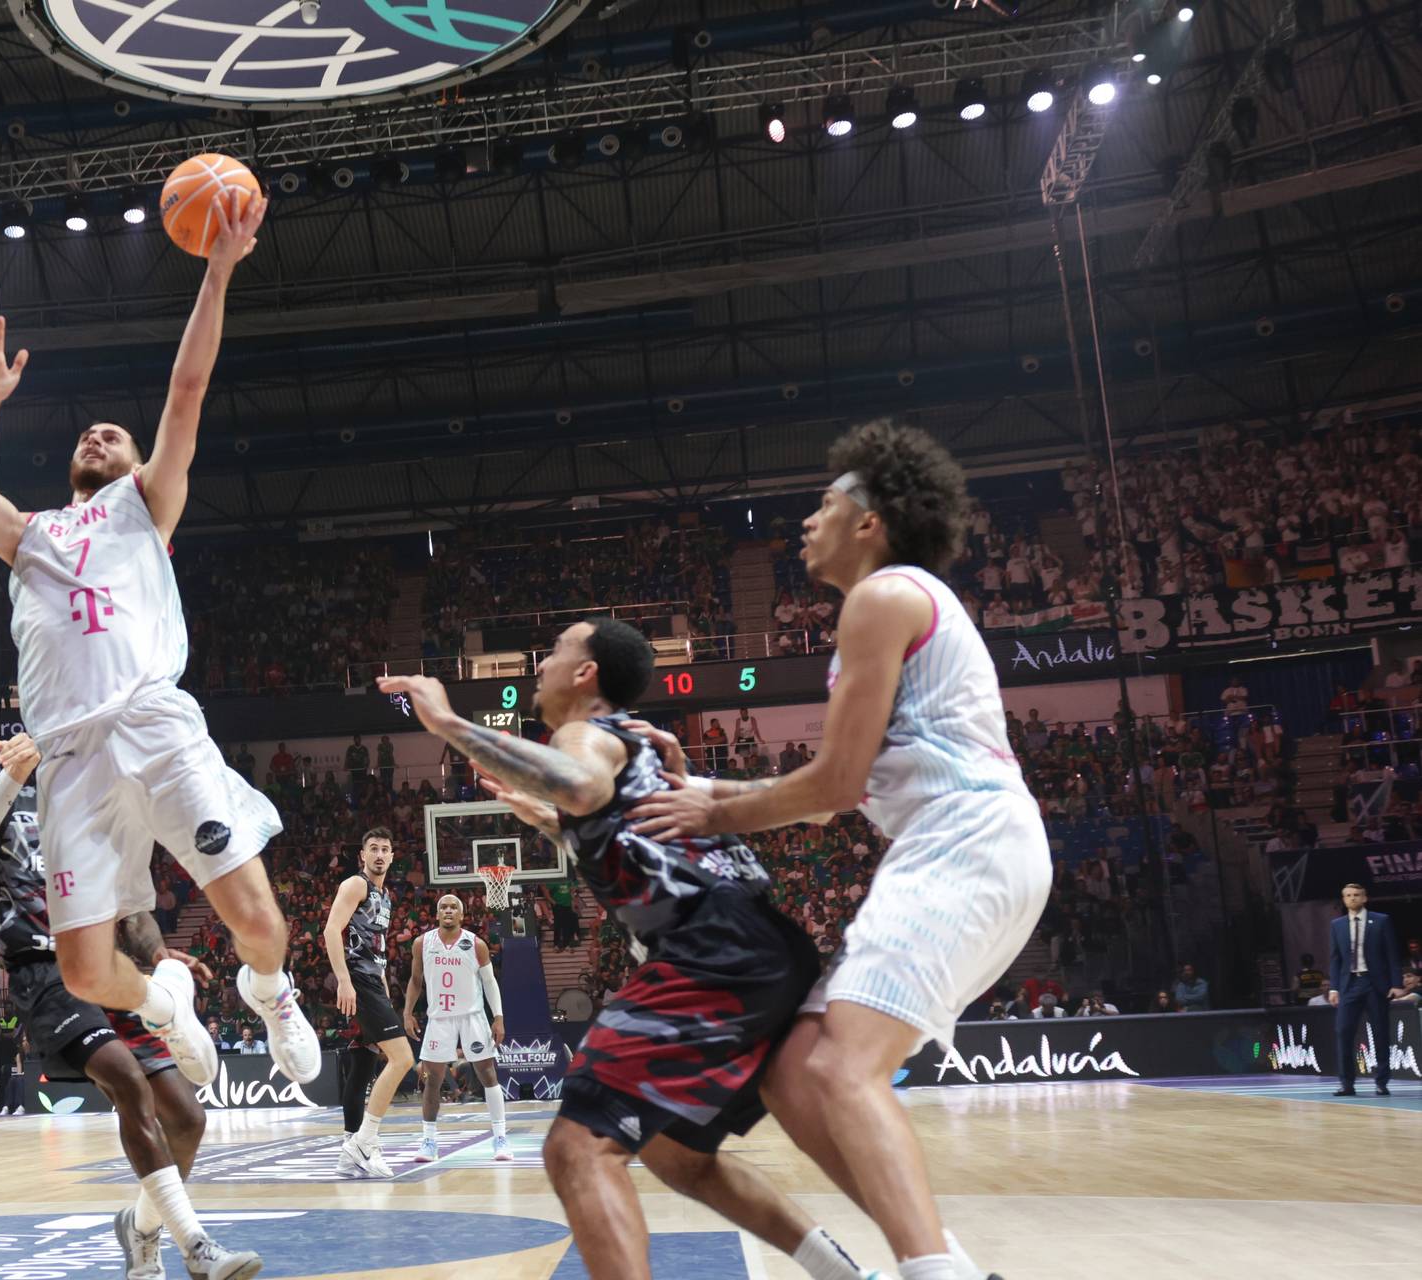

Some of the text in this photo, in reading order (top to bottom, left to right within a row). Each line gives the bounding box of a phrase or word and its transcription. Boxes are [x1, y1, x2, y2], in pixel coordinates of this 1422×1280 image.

[66, 537, 91, 577] 7
[1273, 622, 1352, 641] BONN
[663, 672, 693, 695] 10
[738, 667, 756, 691] 5
[502, 685, 518, 709] 9
[483, 711, 515, 728] 1:27
[434, 956, 462, 966] BONN
[442, 972, 453, 988] 0
[496, 1051, 557, 1064] FINAL FOUR
[934, 1031, 1140, 1083] Andalucía
